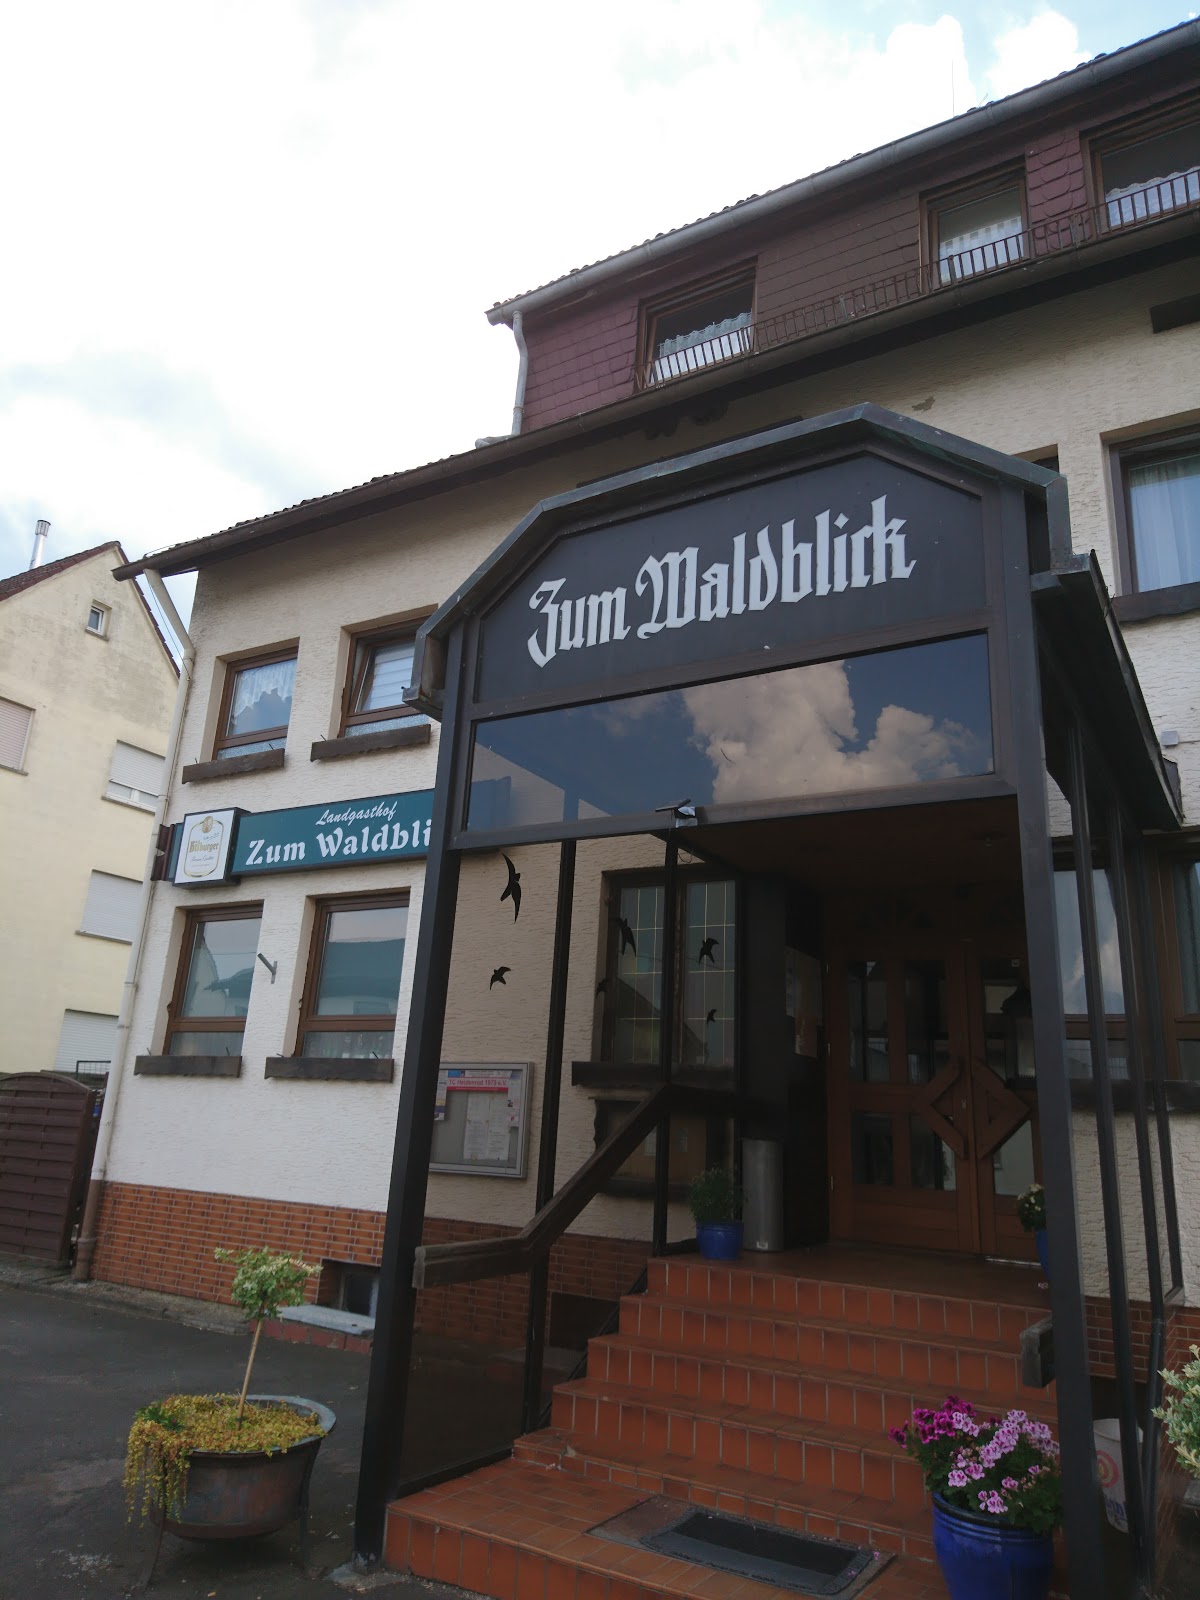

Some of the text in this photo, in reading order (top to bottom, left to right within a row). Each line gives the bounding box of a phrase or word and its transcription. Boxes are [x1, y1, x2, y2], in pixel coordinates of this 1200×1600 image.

[527, 494, 917, 668] Zum Waldblick
[315, 801, 398, 826] Landgasthof
[245, 818, 432, 866] Zum Waldbli
